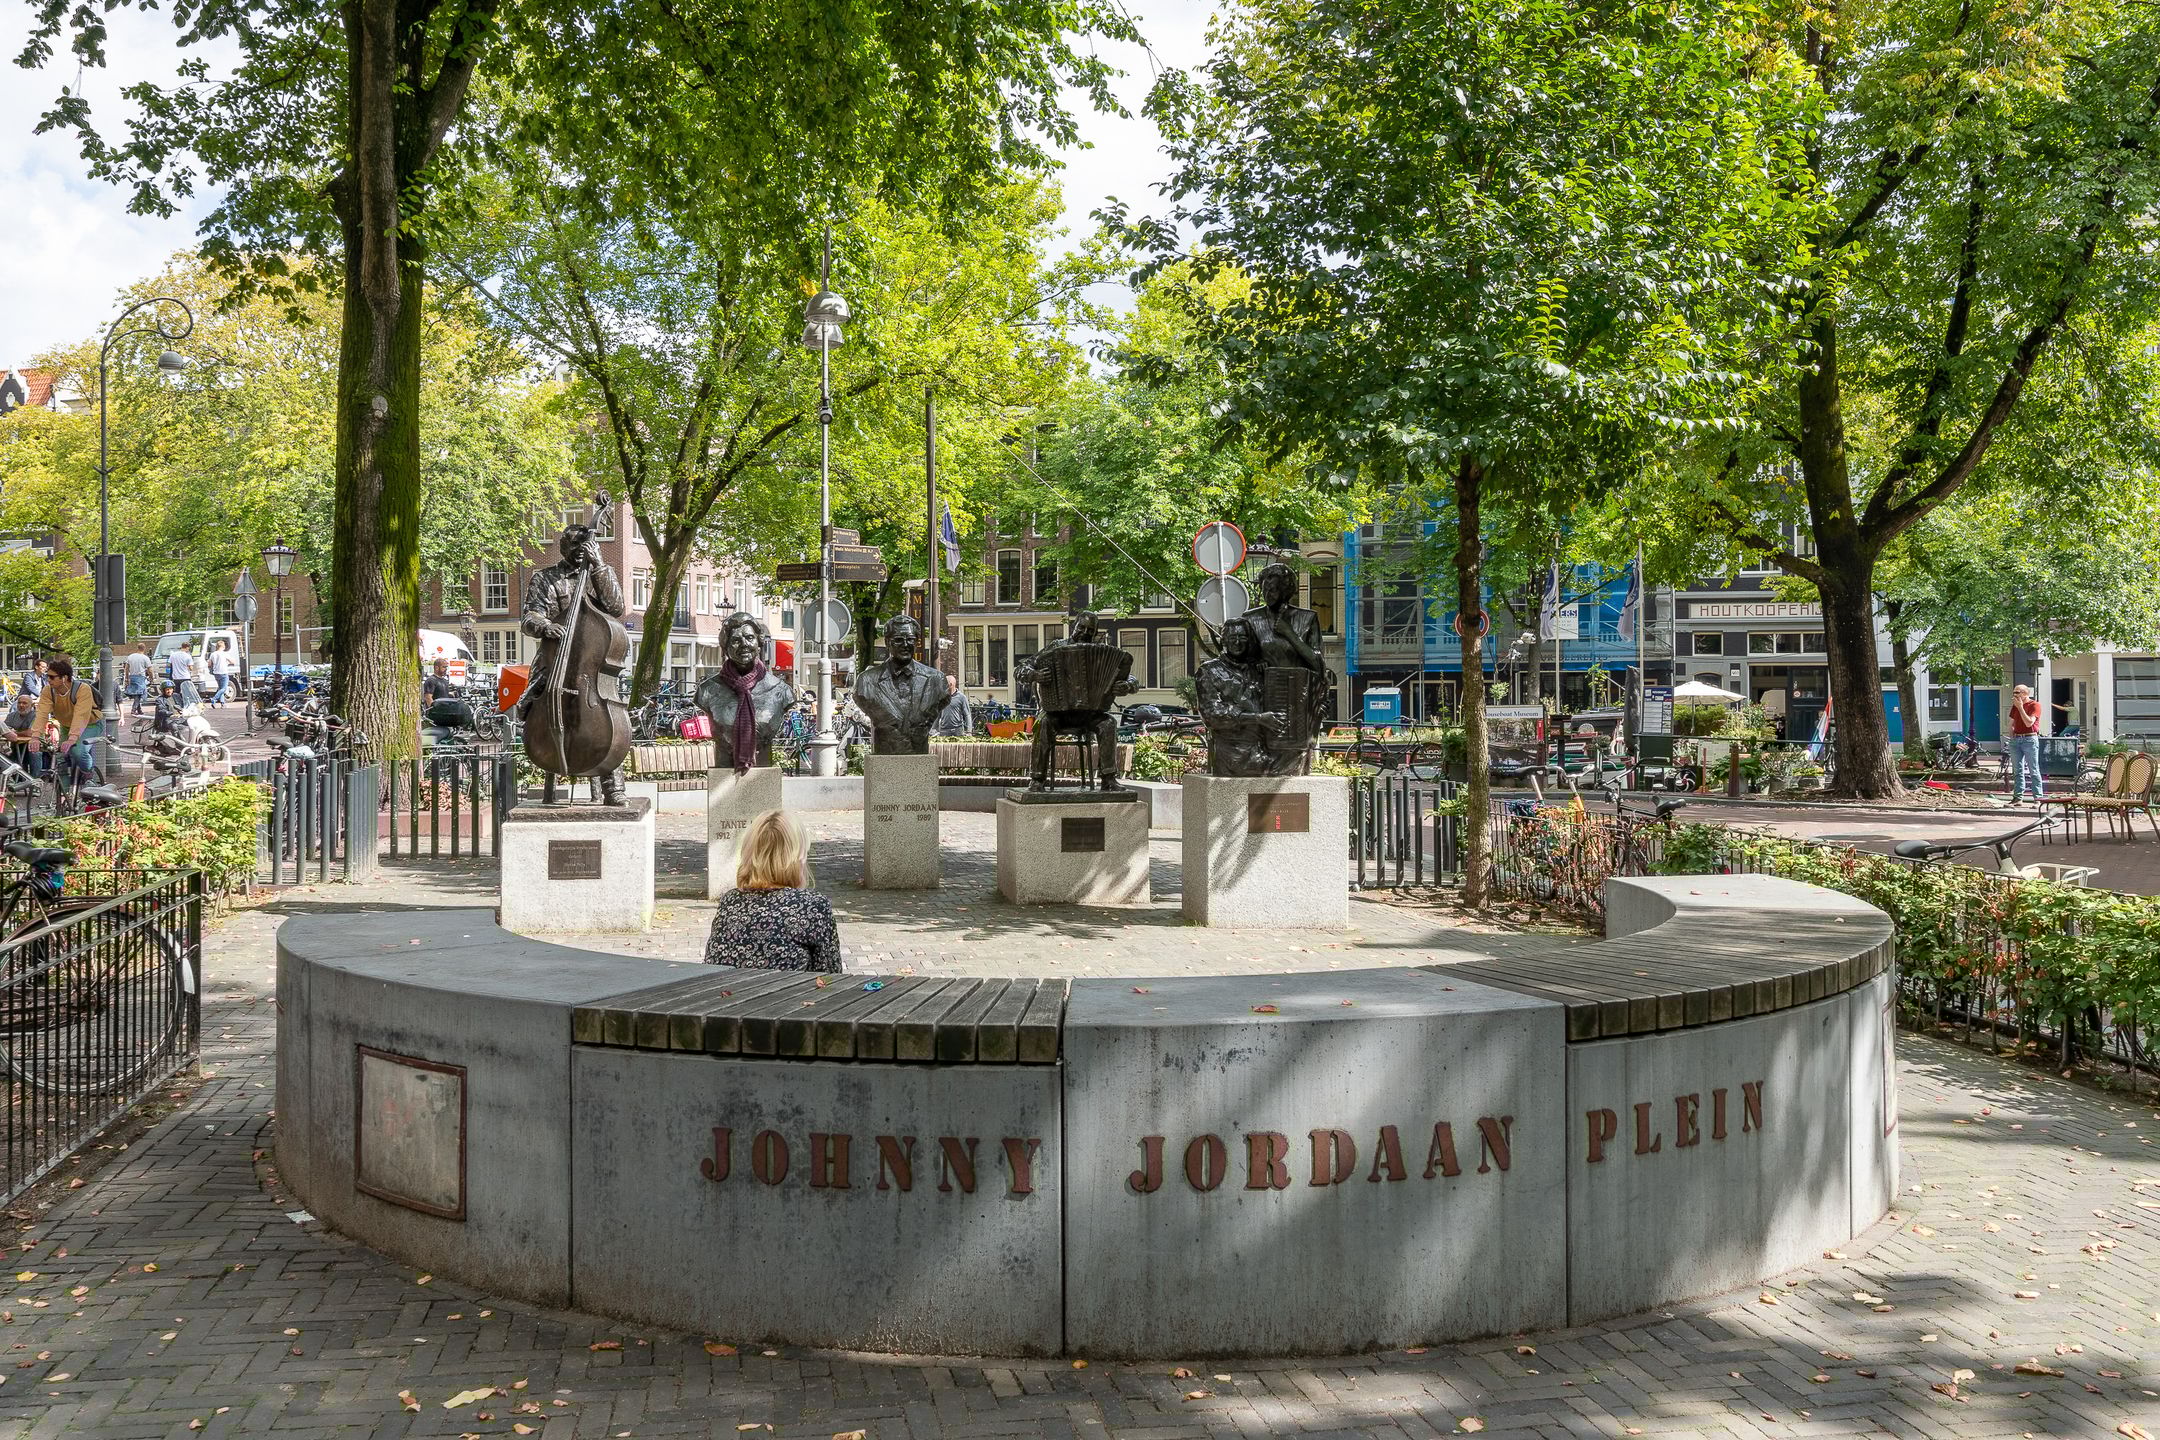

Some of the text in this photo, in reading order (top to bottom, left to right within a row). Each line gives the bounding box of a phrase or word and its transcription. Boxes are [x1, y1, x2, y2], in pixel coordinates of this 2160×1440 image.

[913, 595, 922, 661] MUEU
[872, 803, 937, 812] JOHNNY JORDAAN
[720, 820, 747, 829] TANTE
[715, 831, 731, 840] 1912
[702, 1080, 1764, 1194] JOHNNY JORDAAN PLEIN
